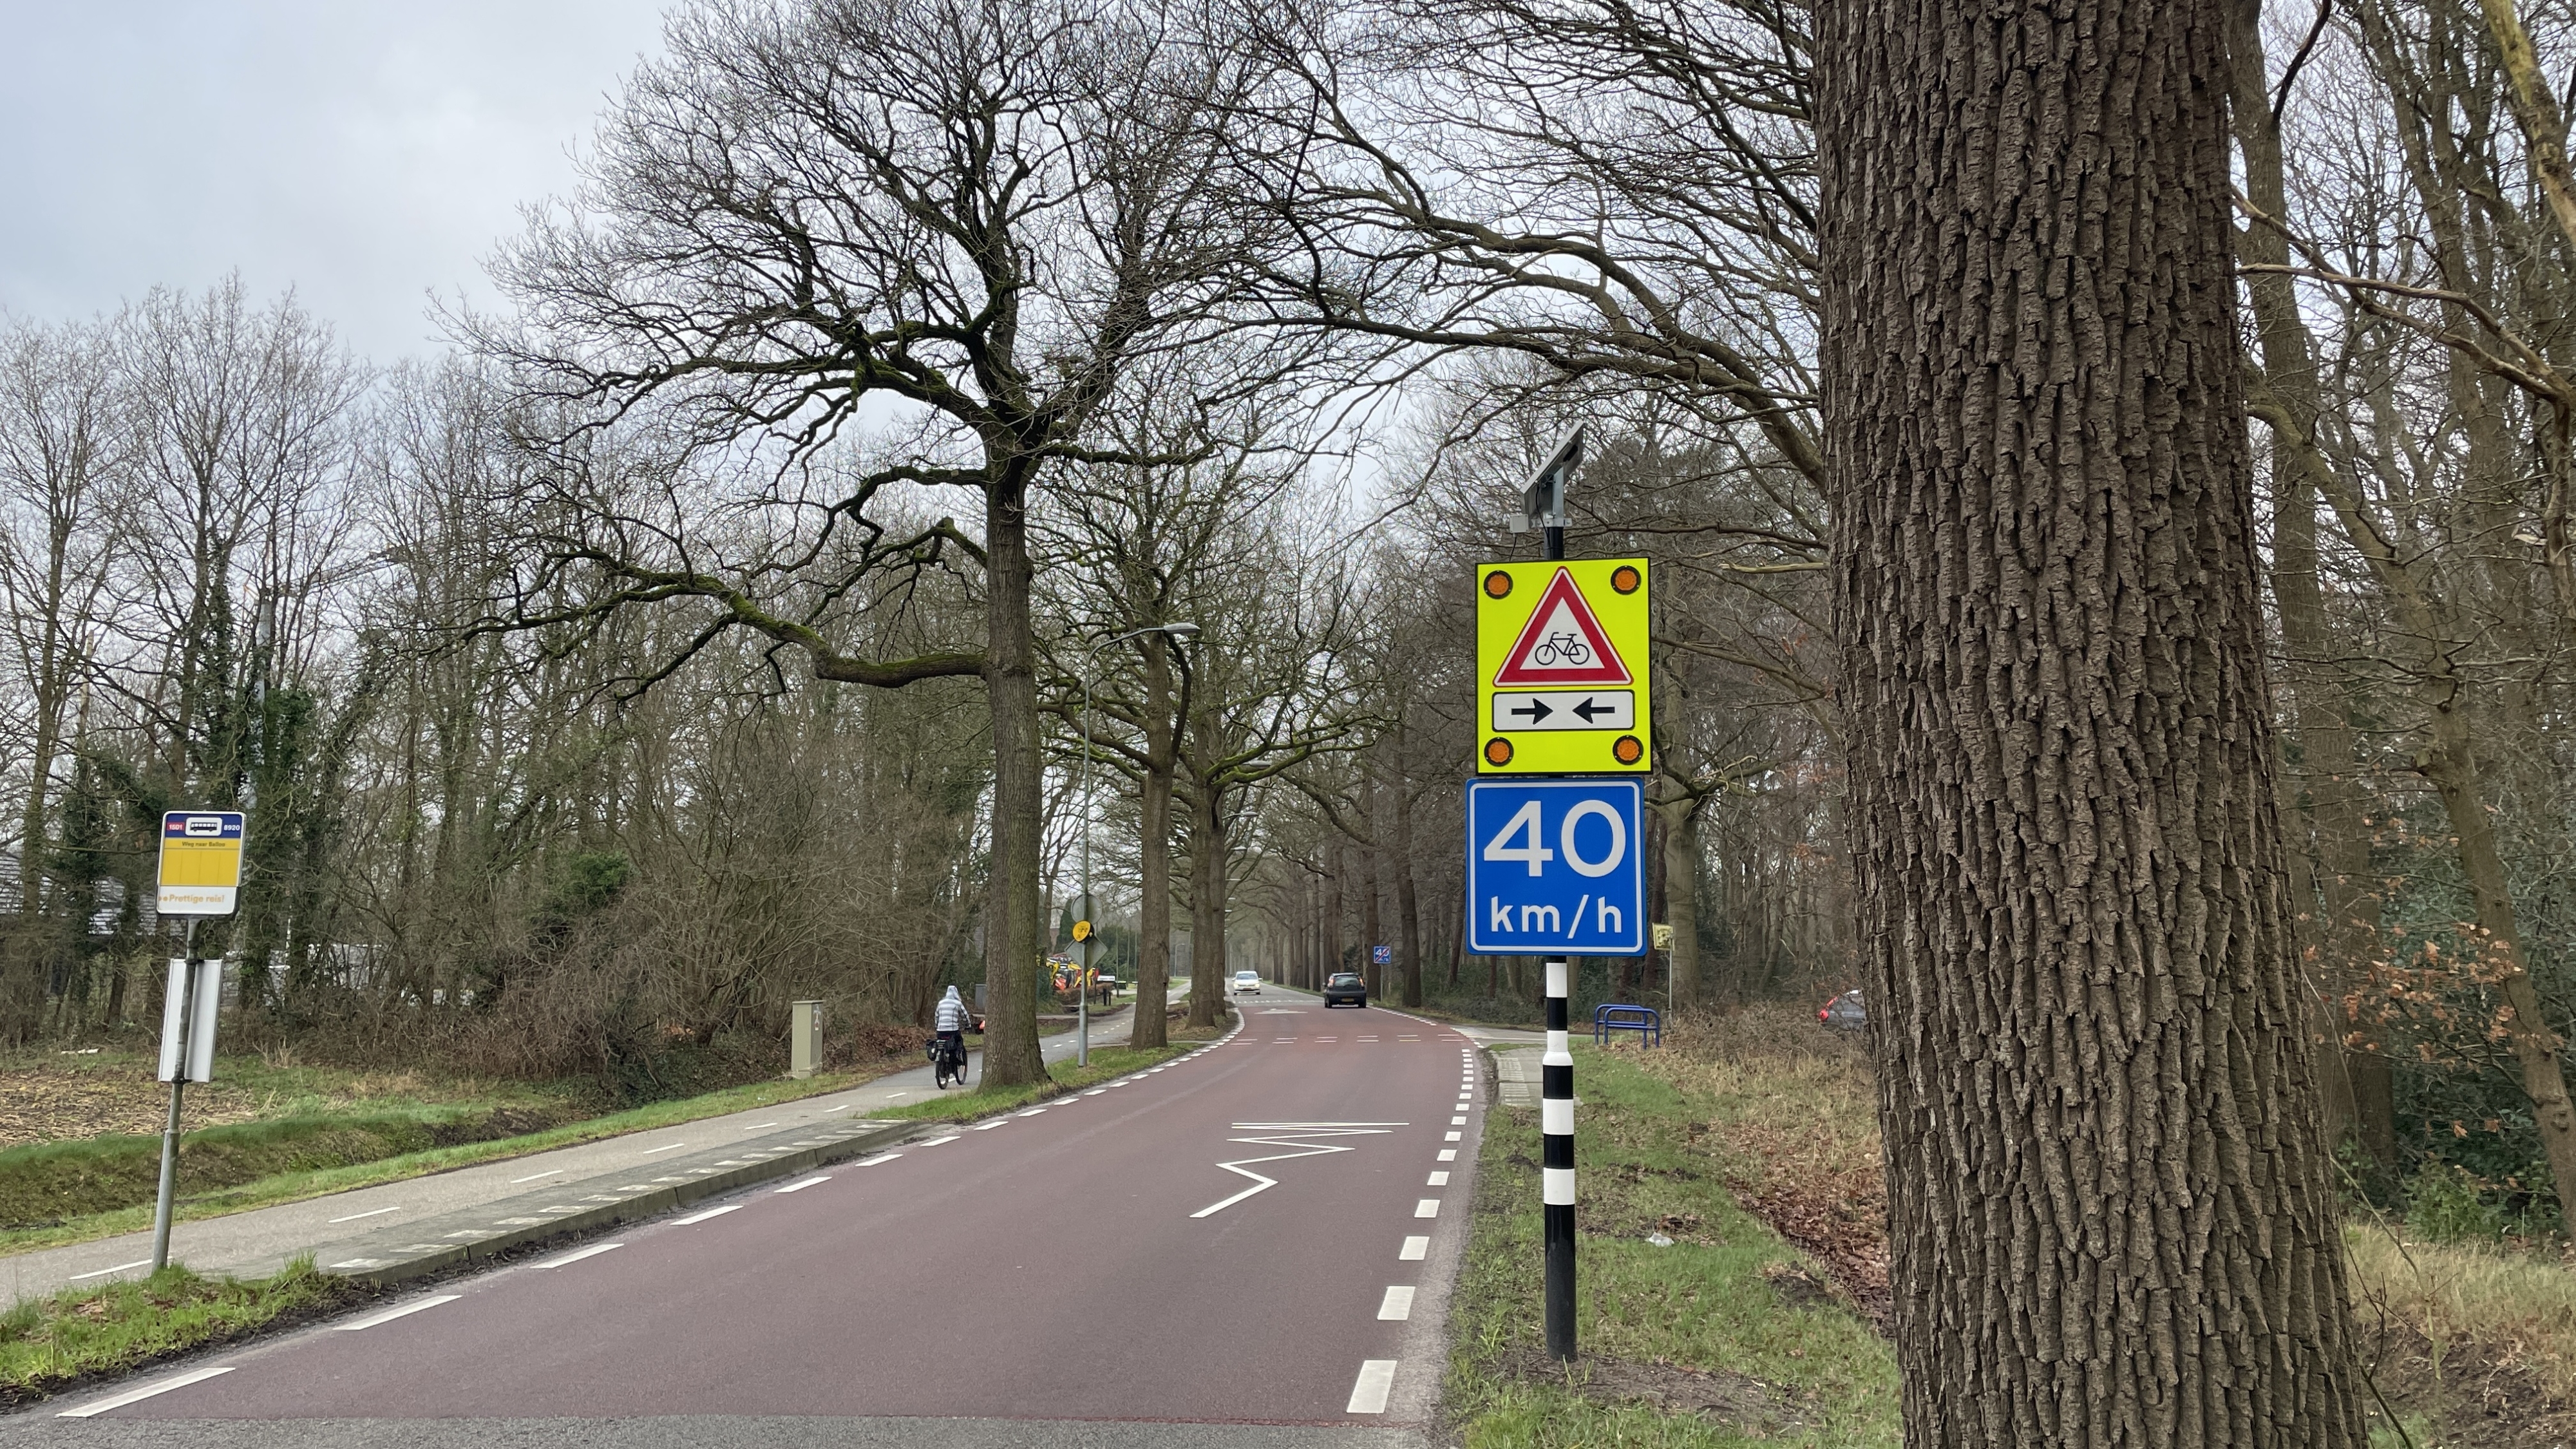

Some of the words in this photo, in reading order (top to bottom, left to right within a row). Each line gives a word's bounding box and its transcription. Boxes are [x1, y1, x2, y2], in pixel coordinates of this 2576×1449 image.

[1484, 799, 1626, 878] 40
[169, 894, 204, 904] Prettige
[206, 895, 225, 903] reis!
[1491, 895, 1622, 939] km/h
